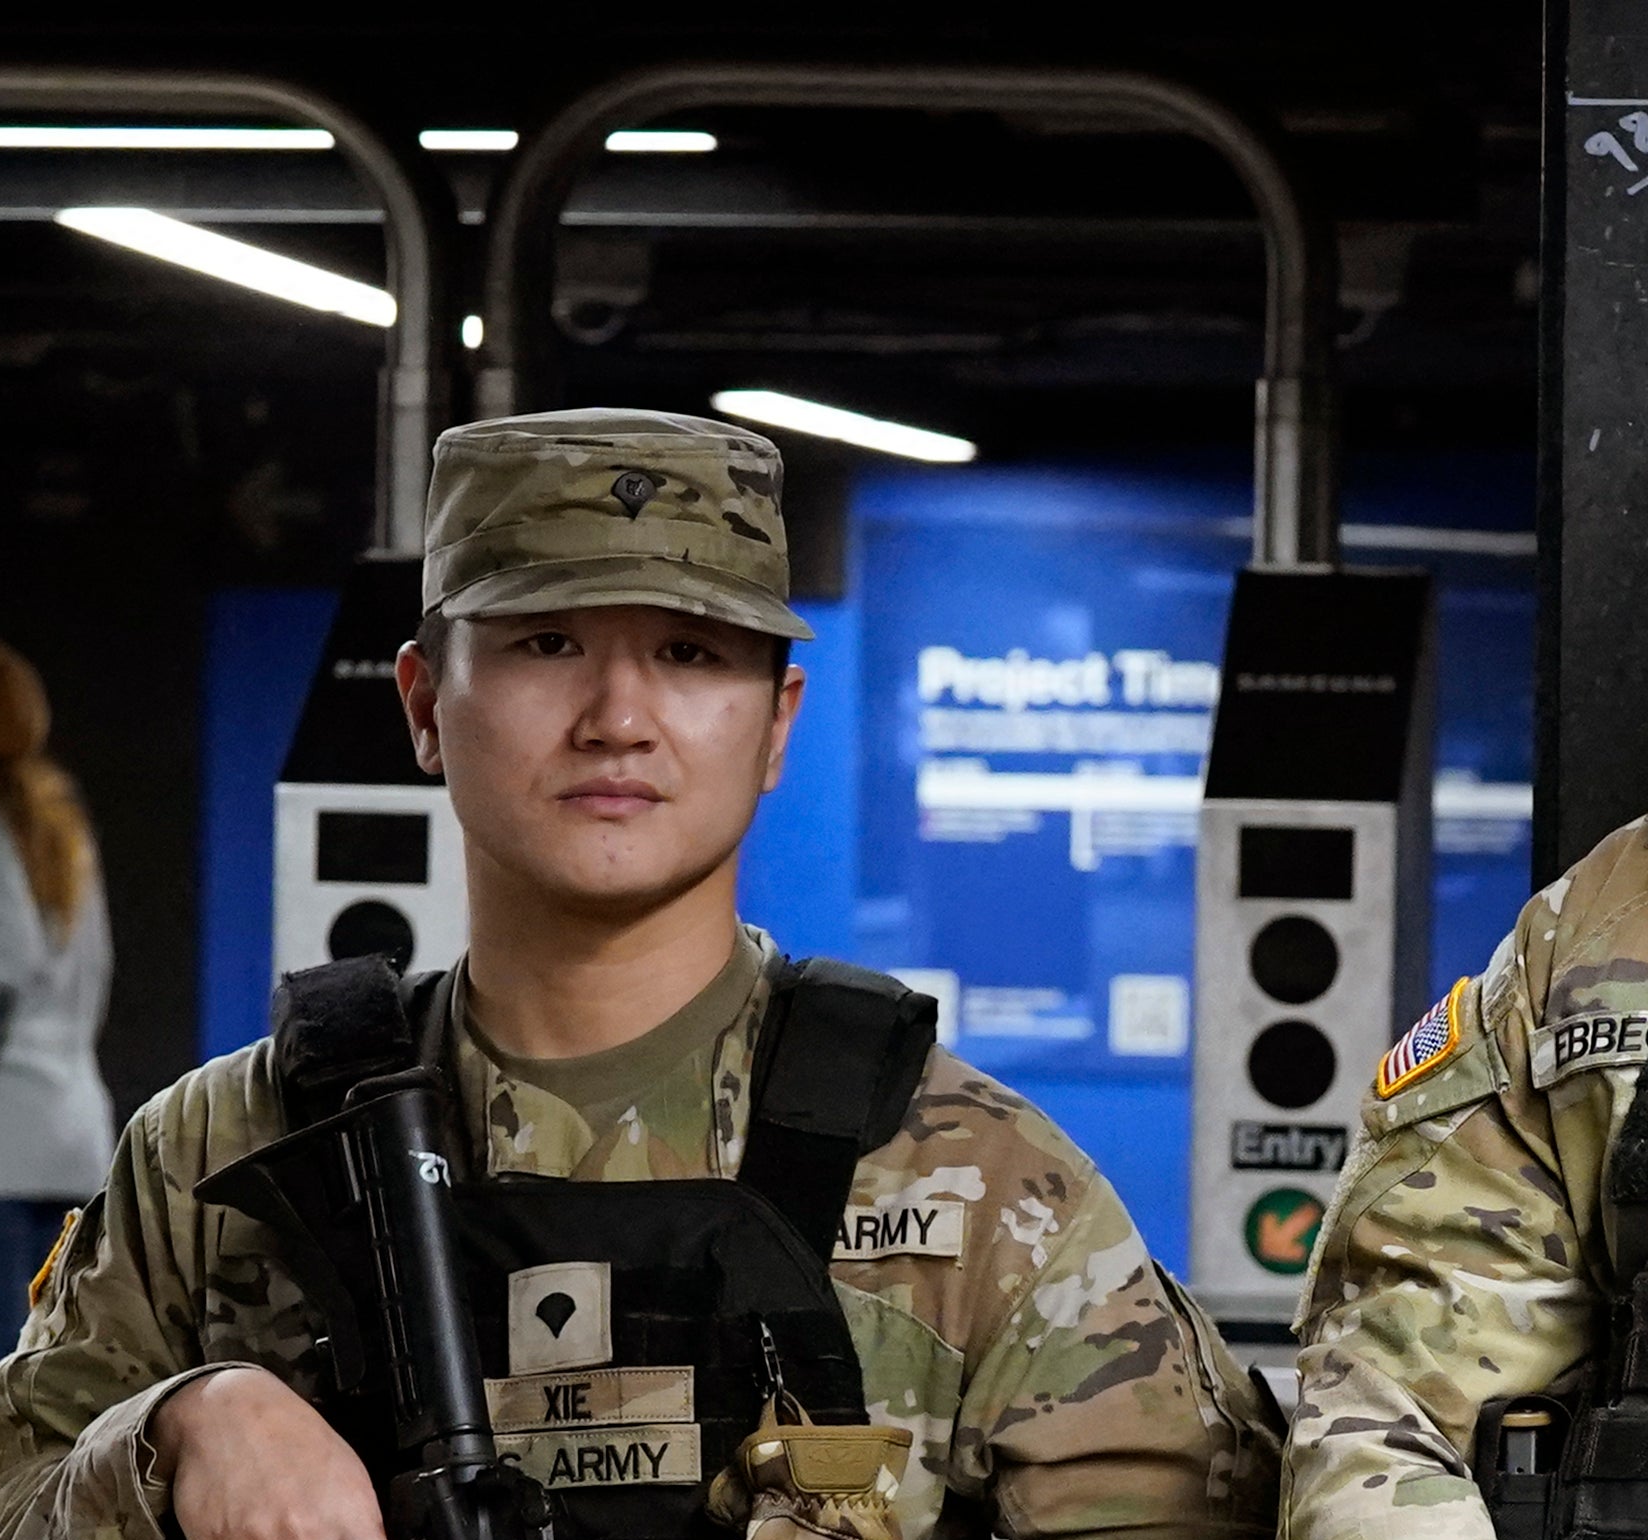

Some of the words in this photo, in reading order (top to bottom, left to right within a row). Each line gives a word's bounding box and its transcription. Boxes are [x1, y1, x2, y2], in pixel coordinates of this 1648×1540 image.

[918, 646, 1110, 712] Project
[1237, 1121, 1343, 1171] Entry
[543, 1382, 592, 1422] XIE
[548, 1442, 670, 1486] ARMY
